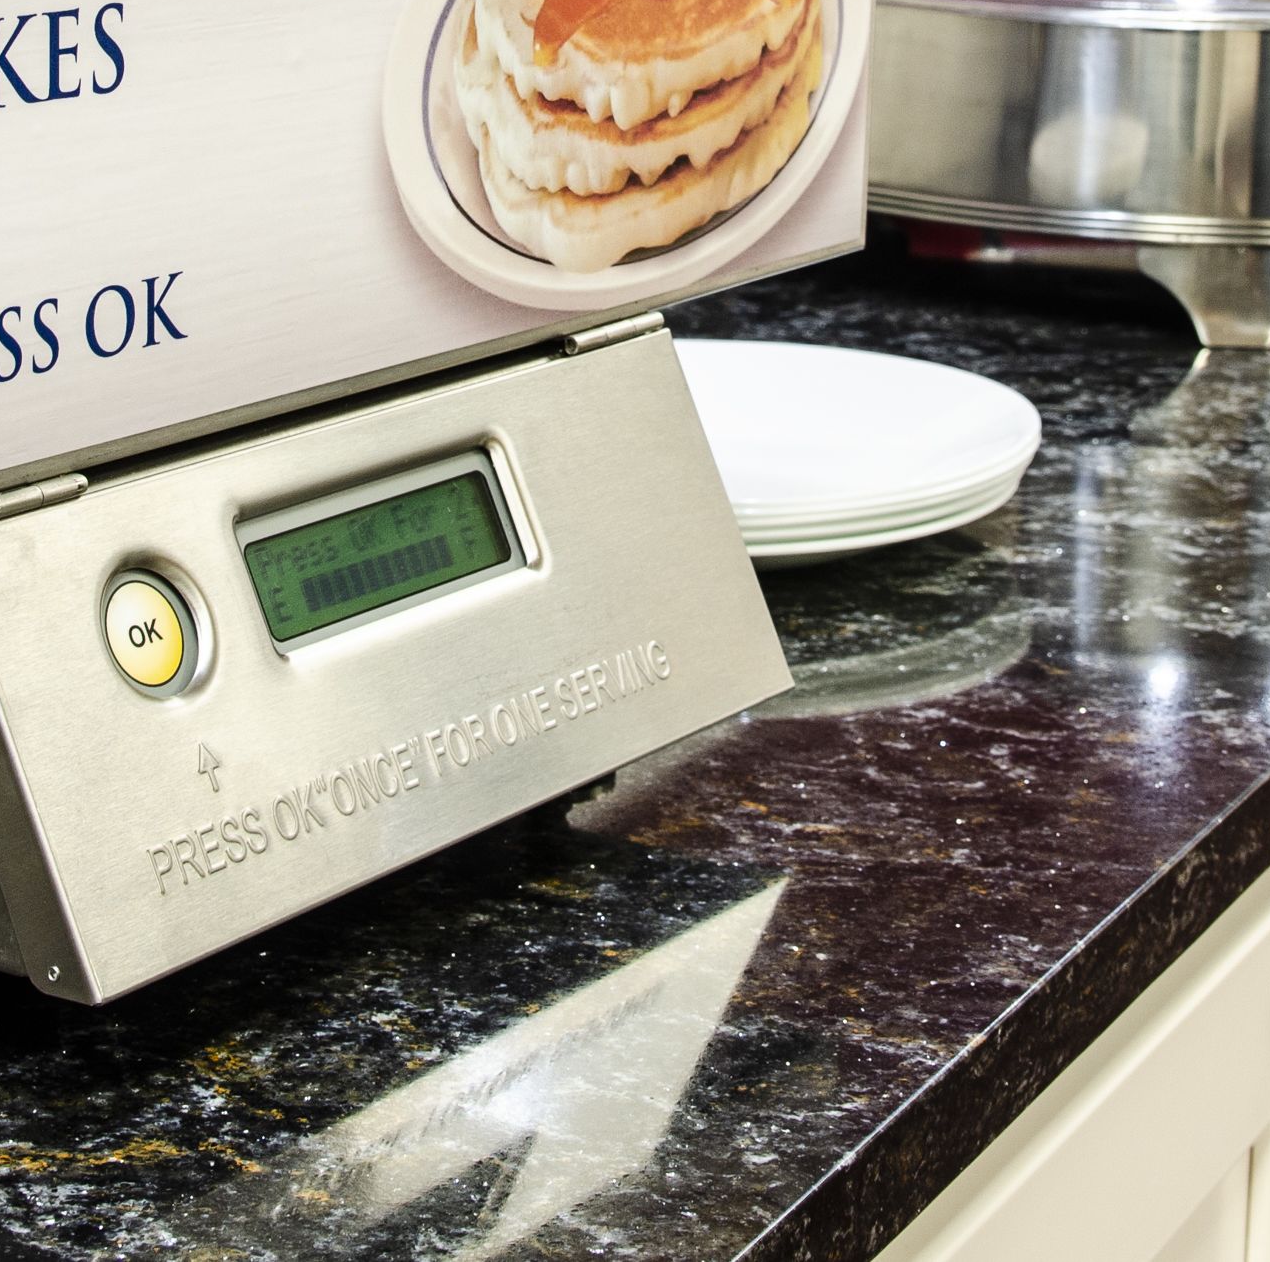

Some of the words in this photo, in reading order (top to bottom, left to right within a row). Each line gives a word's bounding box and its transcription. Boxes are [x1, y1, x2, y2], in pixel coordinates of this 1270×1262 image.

[84, 271, 188, 358] OK
[128, 618, 164, 648] OK
[146, 806, 269, 896] PRESS
[424, 713, 494, 777] FOR
[490, 685, 558, 747] ONE
[555, 639, 672, 720] SERVING
